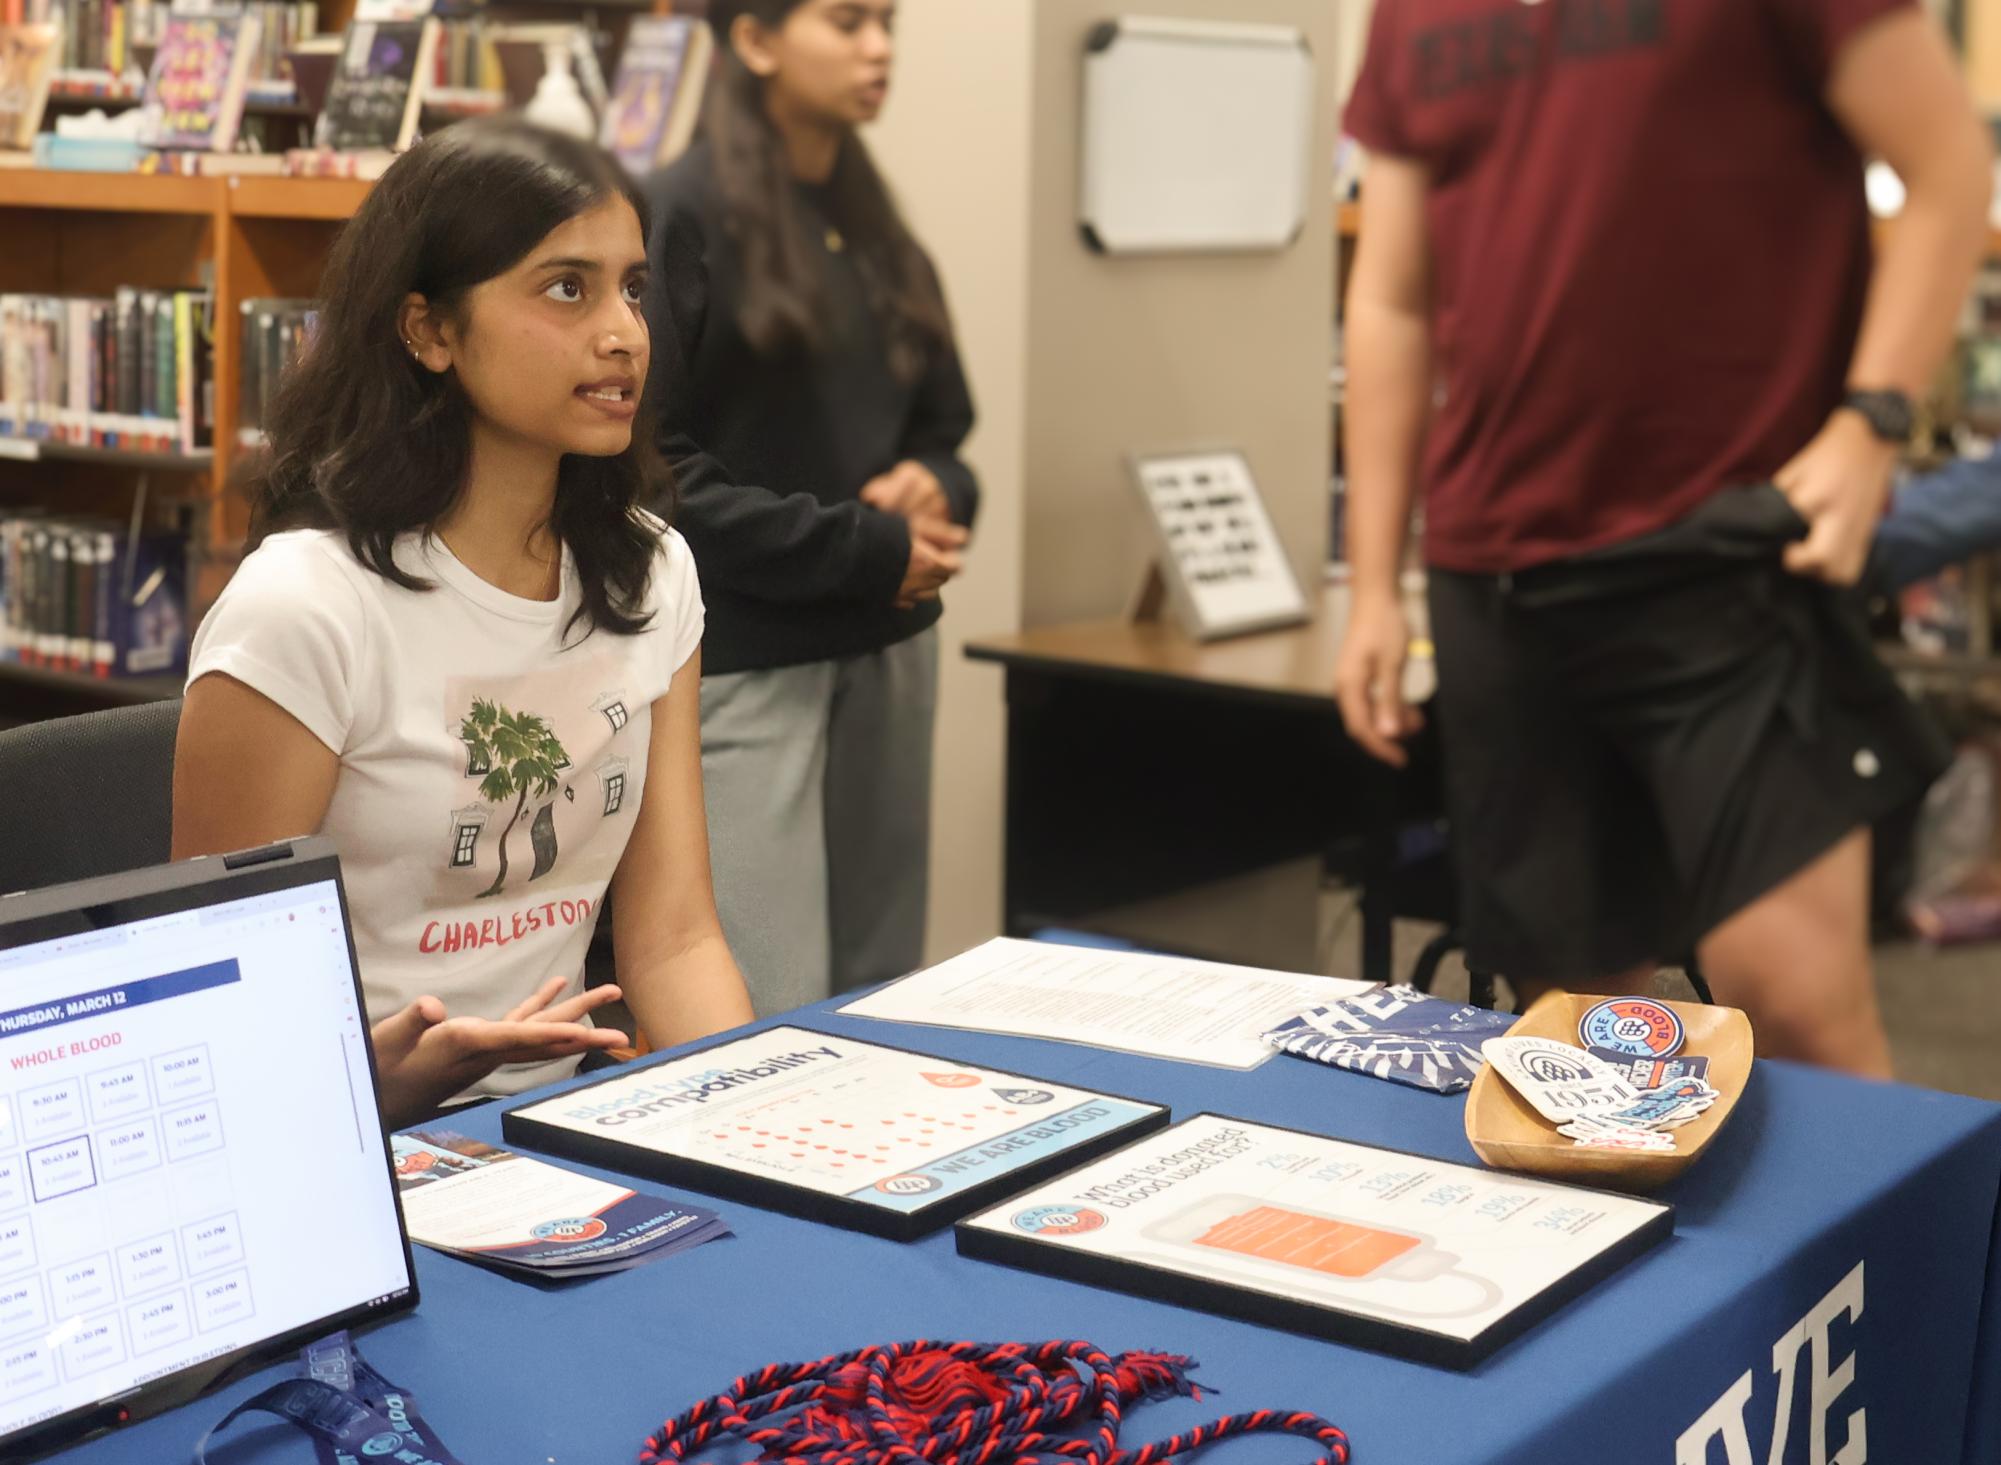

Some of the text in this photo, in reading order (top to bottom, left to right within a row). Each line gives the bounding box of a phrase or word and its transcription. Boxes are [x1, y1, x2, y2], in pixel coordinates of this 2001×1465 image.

[419, 898, 599, 953] CHARLESTON
[0, 991, 127, 1032] HURSDAY, MARCH 12
[1594, 1005, 1671, 1054] WE ARE BLOOD
[10, 1031, 122, 1070] WHOLE BLOOD
[564, 1067, 727, 1120] Blood type
[595, 1046, 844, 1127] compatibility
[1544, 1083, 1630, 1109] 1951
[932, 1106, 1112, 1175] WE ARE BLOOD
[1073, 1127, 1248, 1205] What is donated
[1102, 1139, 1259, 1209] blood used for?
[1421, 1184, 1473, 1209] 18%
[1475, 1195, 1526, 1219] 19%
[1534, 1207, 1587, 1232] 34%
